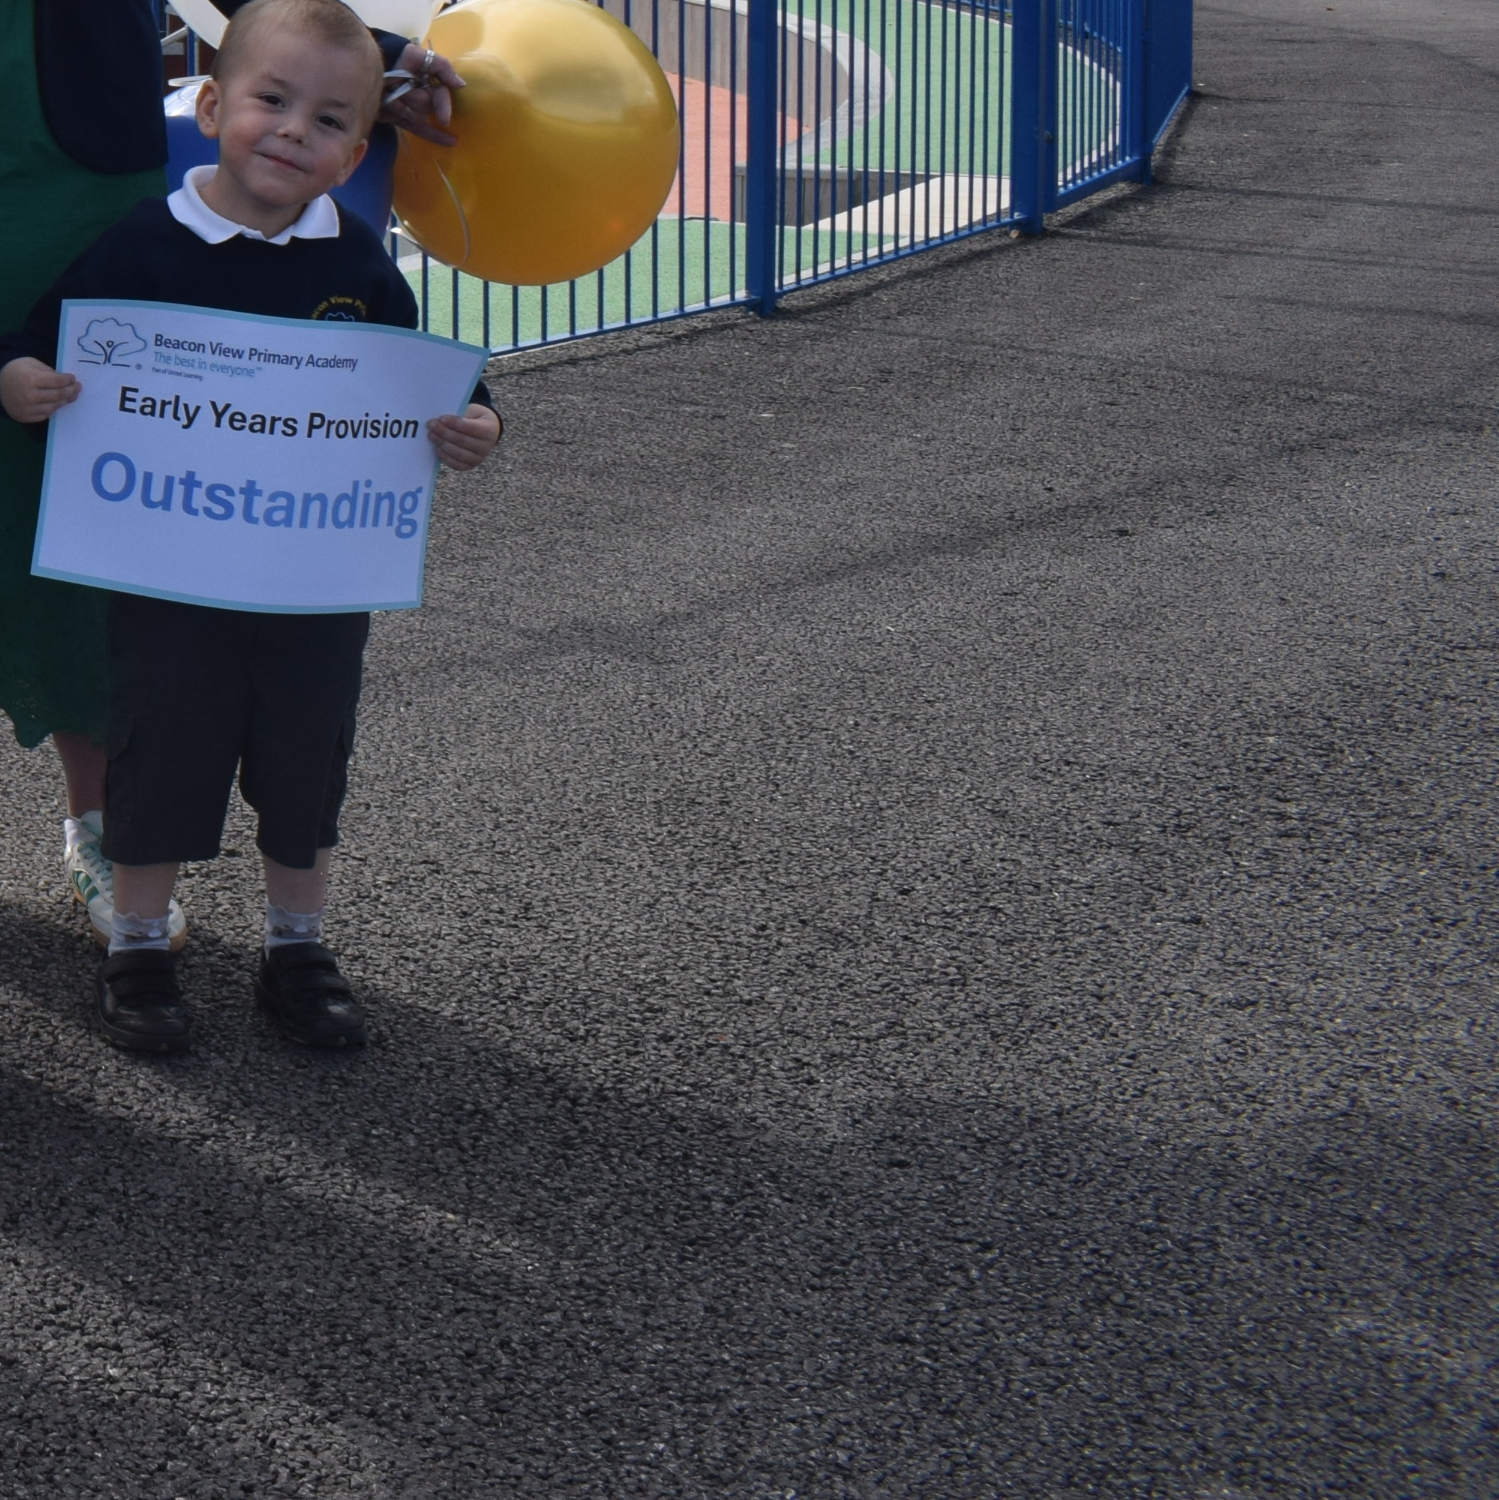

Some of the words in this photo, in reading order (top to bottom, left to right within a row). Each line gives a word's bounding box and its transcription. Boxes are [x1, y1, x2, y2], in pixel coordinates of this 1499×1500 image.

[154, 333, 206, 354] Beacon
[209, 341, 245, 359] View
[248, 347, 303, 370] Primary
[305, 353, 358, 372] Academy
[154, 351, 171, 364] The
[174, 353, 195, 368] best
[198, 357, 207, 370] in
[118, 385, 201, 430] Early
[209, 401, 298, 438] Years
[306, 412, 419, 440] Provision
[91, 451, 423, 540] Outstanding
